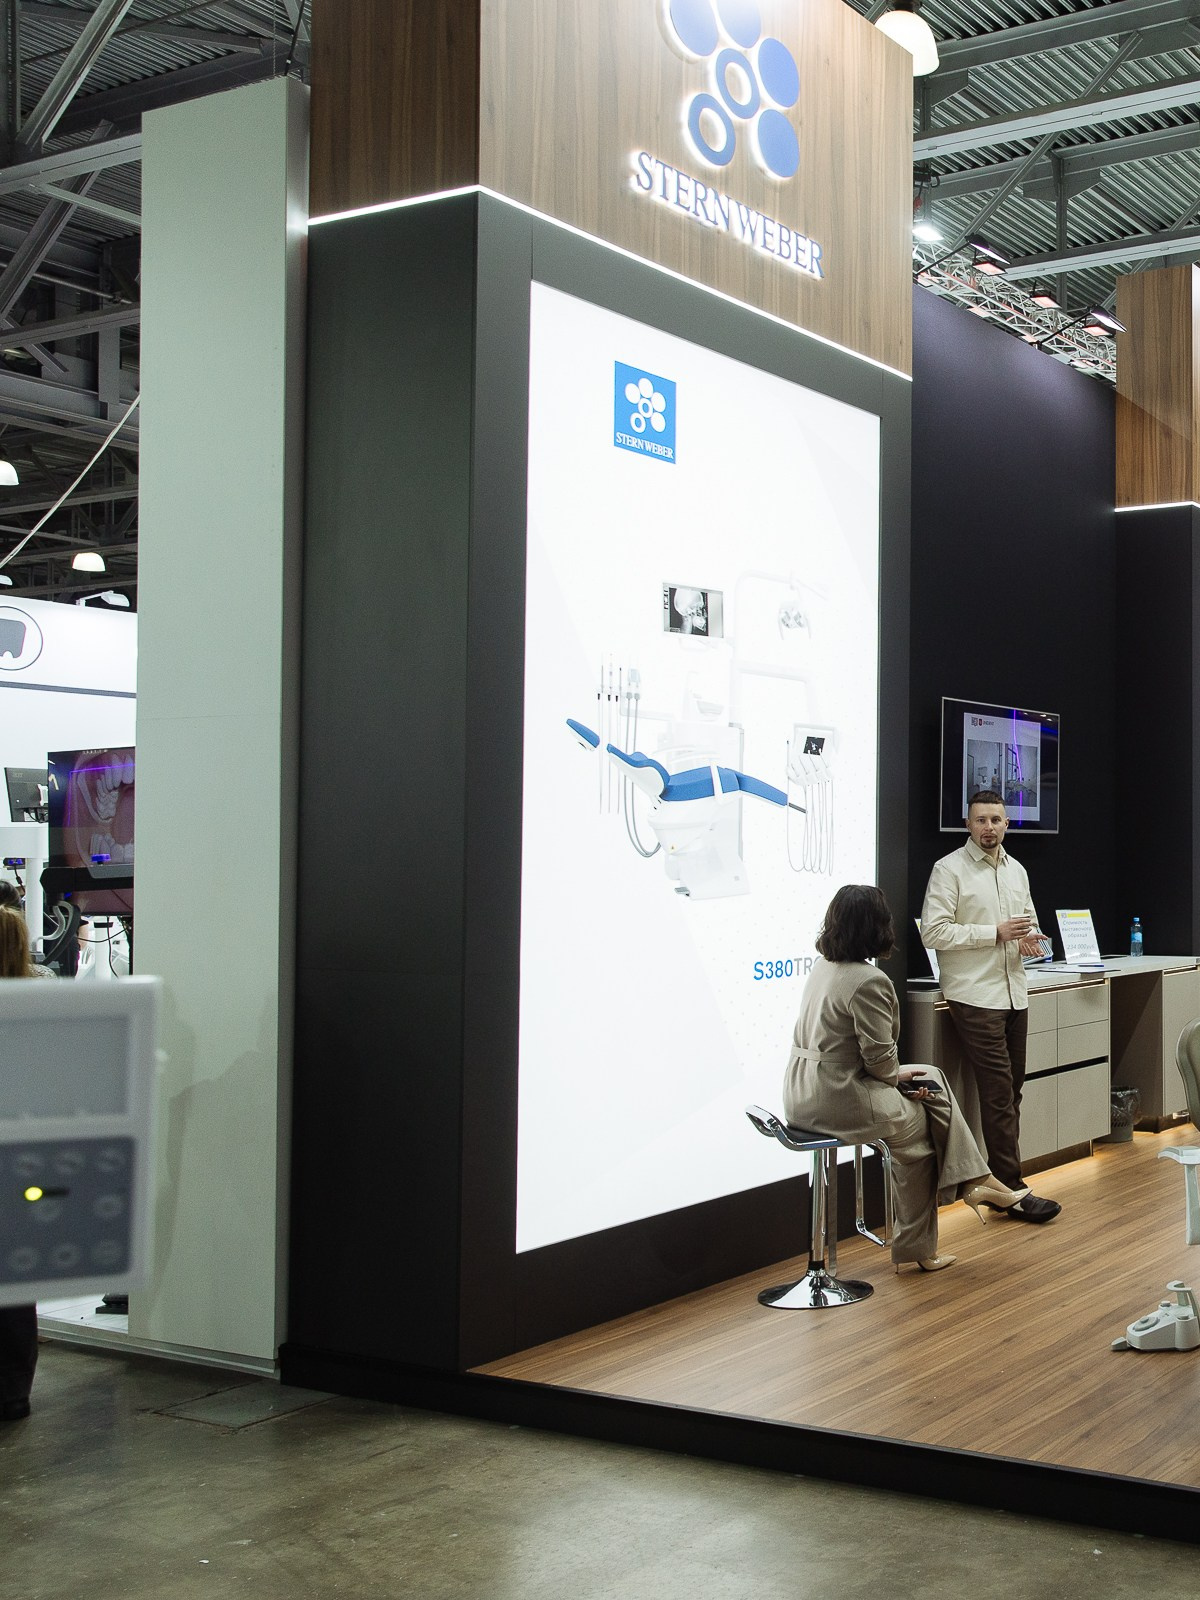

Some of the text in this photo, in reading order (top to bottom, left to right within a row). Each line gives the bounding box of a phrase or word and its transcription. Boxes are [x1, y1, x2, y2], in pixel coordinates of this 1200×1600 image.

[635, 151, 825, 279] STERN WEBER
[616, 431, 674, 459] STERN WEBER
